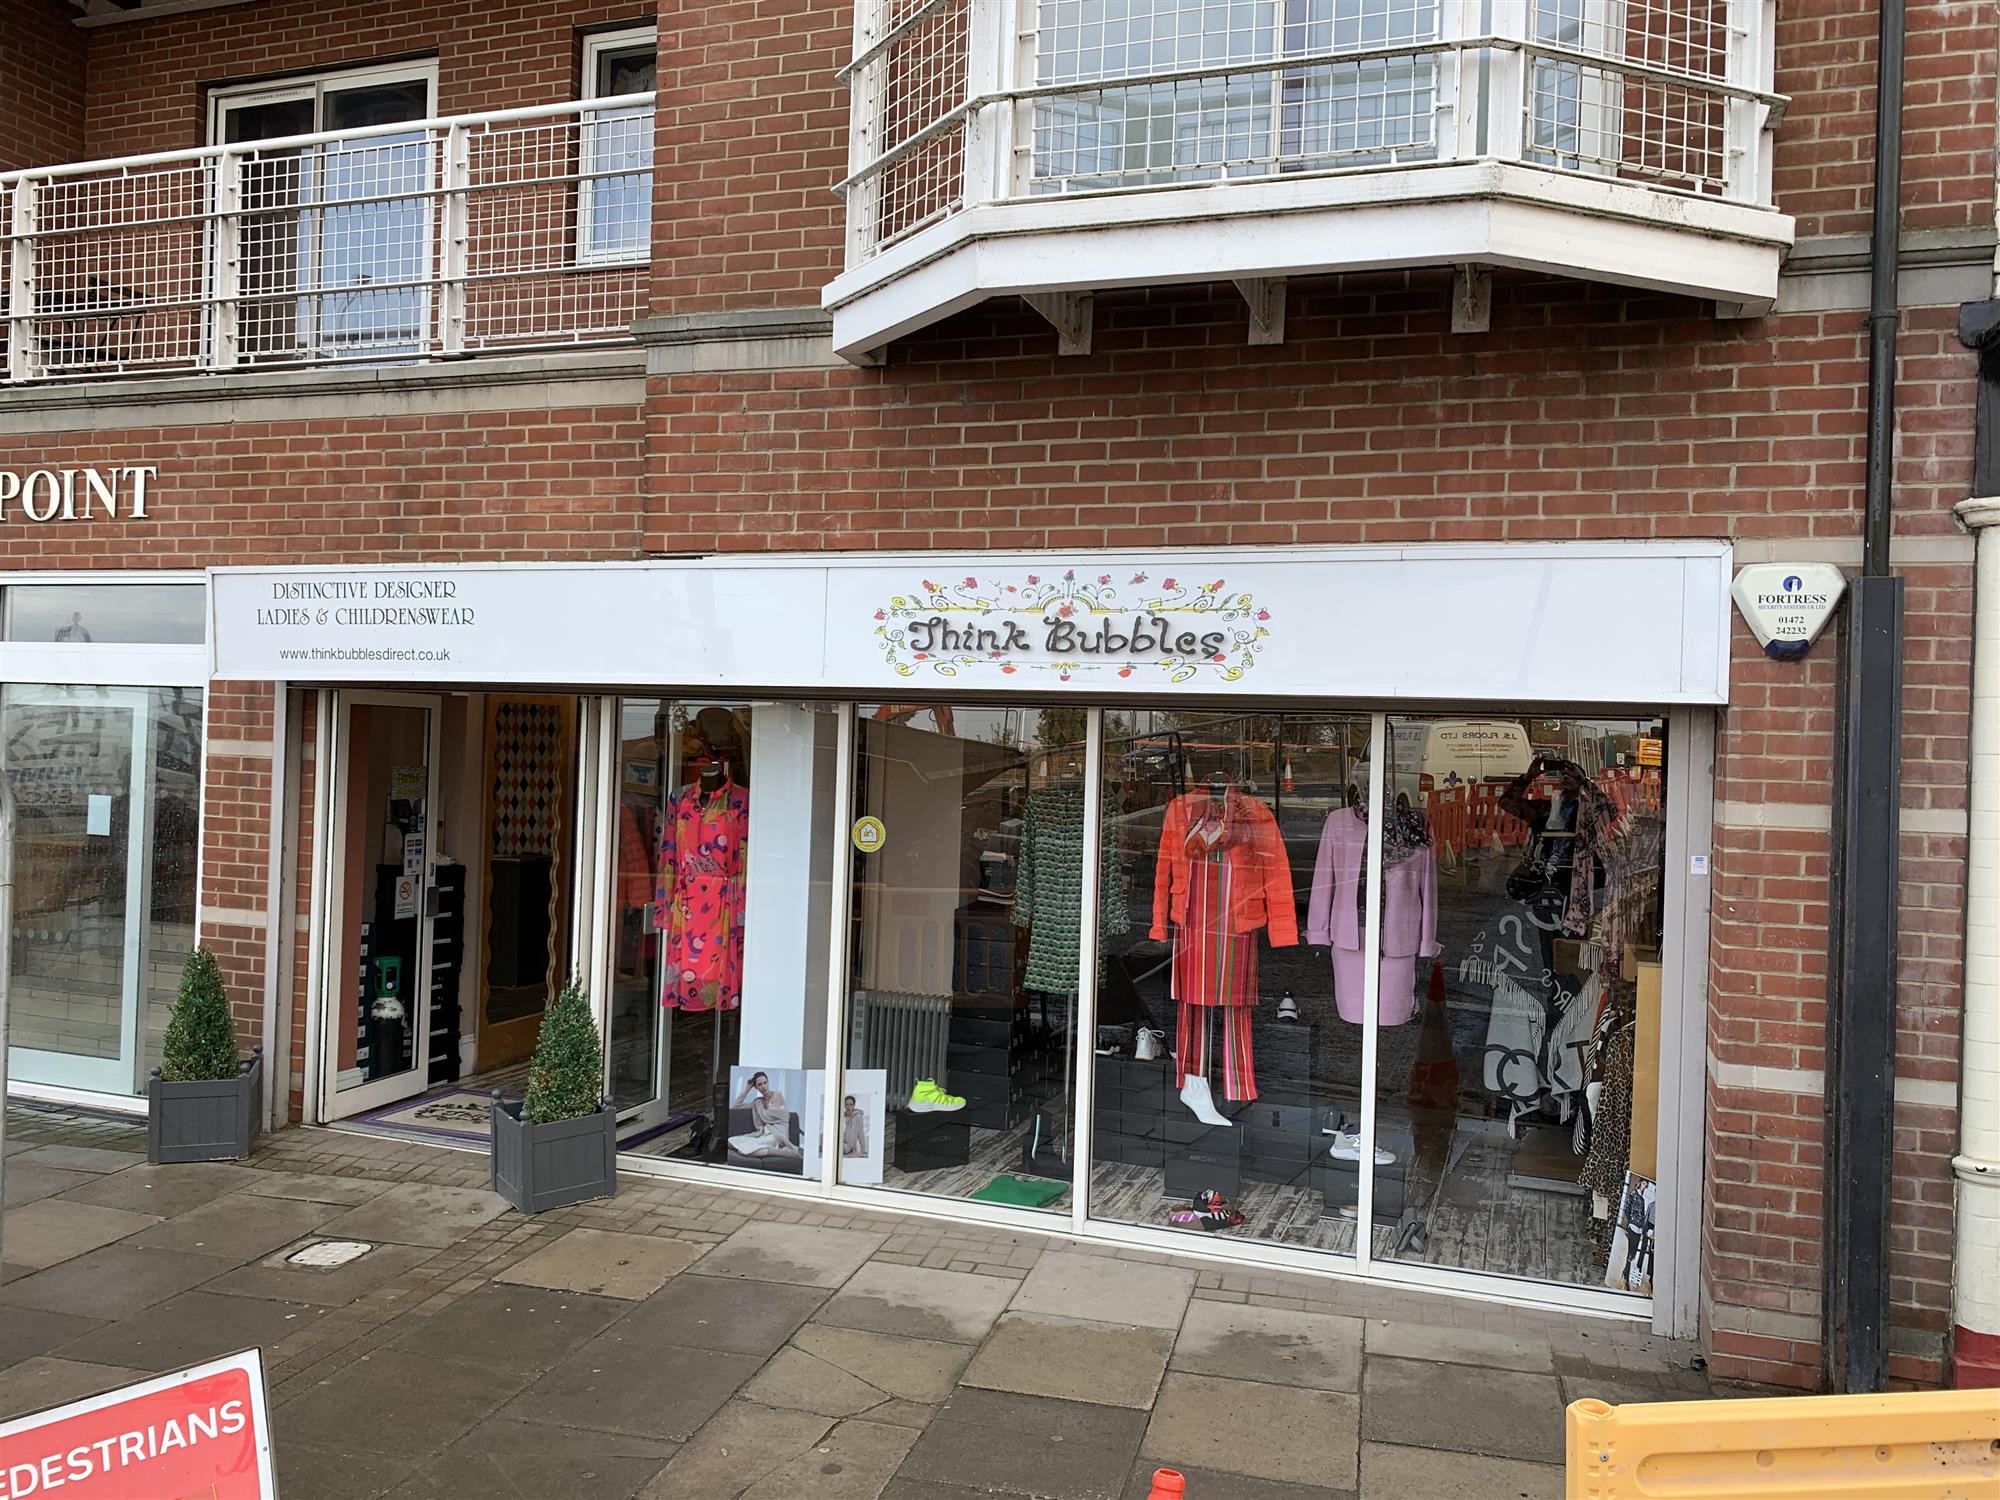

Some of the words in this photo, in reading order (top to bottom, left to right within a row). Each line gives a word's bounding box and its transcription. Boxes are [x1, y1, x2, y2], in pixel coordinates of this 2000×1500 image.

[0, 466, 158, 522] POINT
[272, 582, 368, 600] DISTINCTIVE
[374, 580, 457, 599] DESIGNER
[1758, 594, 1827, 604] FORTRESS
[256, 608, 311, 626] LADIES
[316, 608, 330, 626] &
[335, 607, 475, 626] CHILDRENSWEAR
[1778, 616, 1805, 624] 01472
[908, 616, 1030, 653] Think
[1043, 615, 1226, 659] Bubbles
[1775, 627, 1807, 635] 242232
[279, 647, 451, 662] www.thinkbubblesdirect.co.uk
